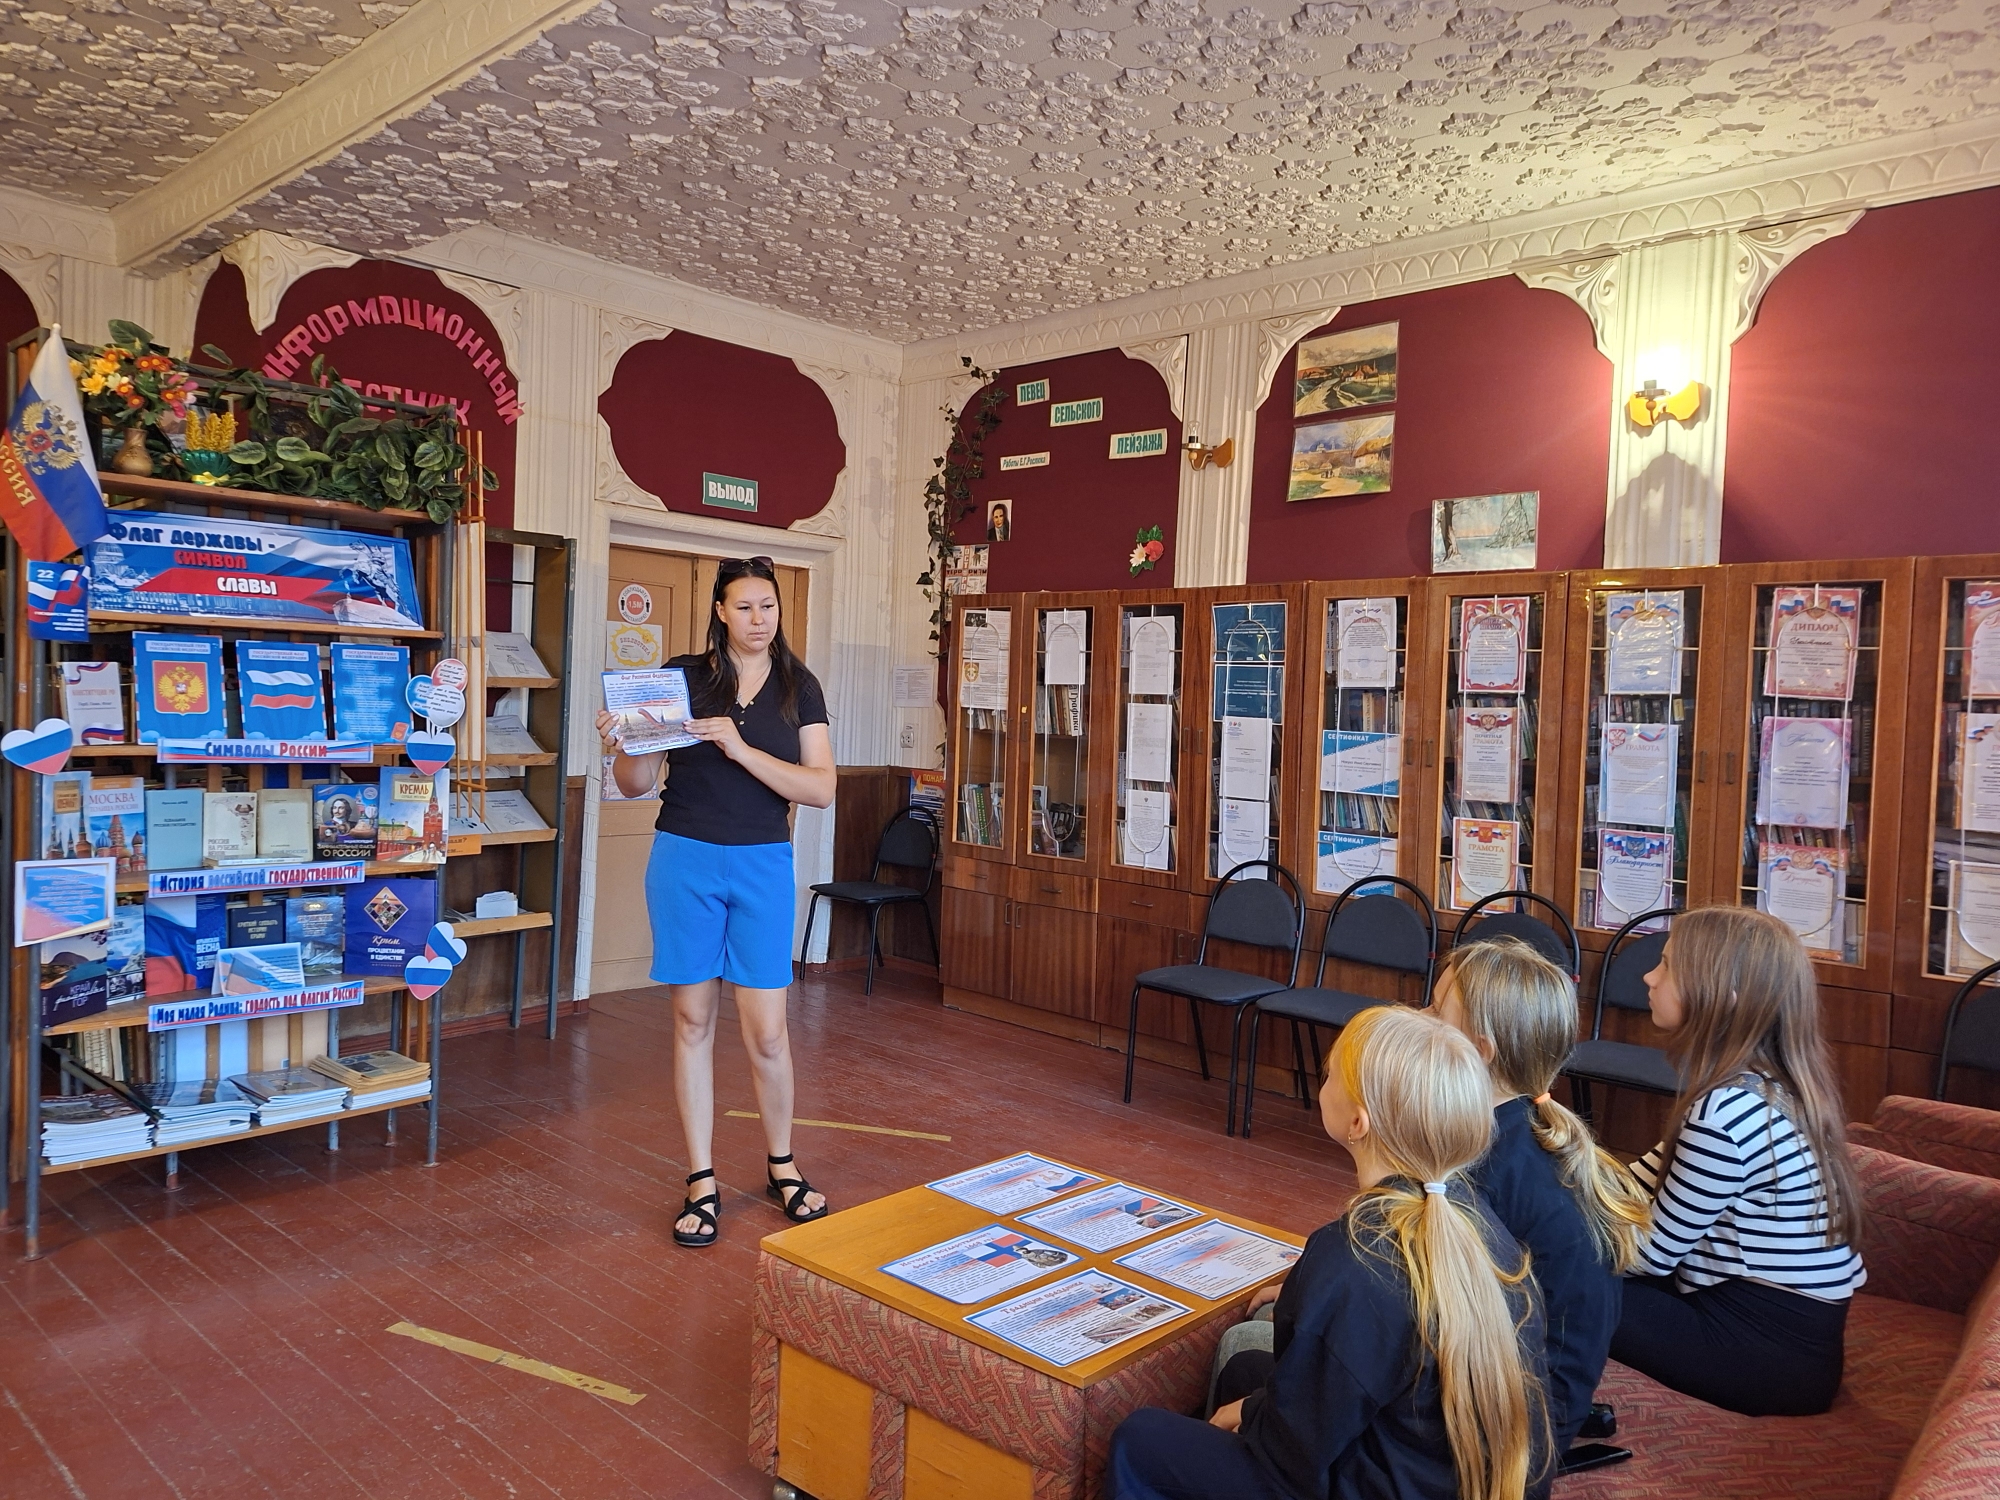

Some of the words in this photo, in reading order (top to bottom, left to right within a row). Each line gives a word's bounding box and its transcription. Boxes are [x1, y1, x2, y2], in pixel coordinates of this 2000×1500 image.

[1020, 381, 1046, 403] ПЕВЕЦ
[1054, 400, 1101, 424] СЕЛЬСКОГО
[1116, 432, 1163, 455] ПЕЙЗАЖА
[708, 481, 755, 507] ВЫХОД
[107, 522, 164, 543] Флаг
[170, 529, 263, 552] державы
[37, 569, 55, 579] 22
[1790, 623, 1839, 632] ДИПЛОМ
[205, 741, 275, 757] Символы
[279, 742, 327, 757] России
[1626, 744, 1660, 752] ГРАМОТА
[399, 784, 430, 795] КРЕМЛЬ
[323, 849, 331, 857] О
[333, 849, 371, 857] РОССИИ
[1468, 843, 1505, 853] ГРАМОТА
[160, 874, 205, 892] История
[208, 868, 266, 889] российской
[268, 865, 359, 886] государственности
[196, 941, 220, 954] ВЕСНА
[157, 1007, 175, 1025] Моя
[178, 1006, 206, 1022] малая
[245, 996, 281, 1014] гордость
[284, 993, 298, 1009] под
[333, 986, 359, 1002] России
[900, 1254, 932, 1267] История
[1000, 1297, 1044, 1315] Традиции
[1044, 1280, 1085, 1299] праздника
